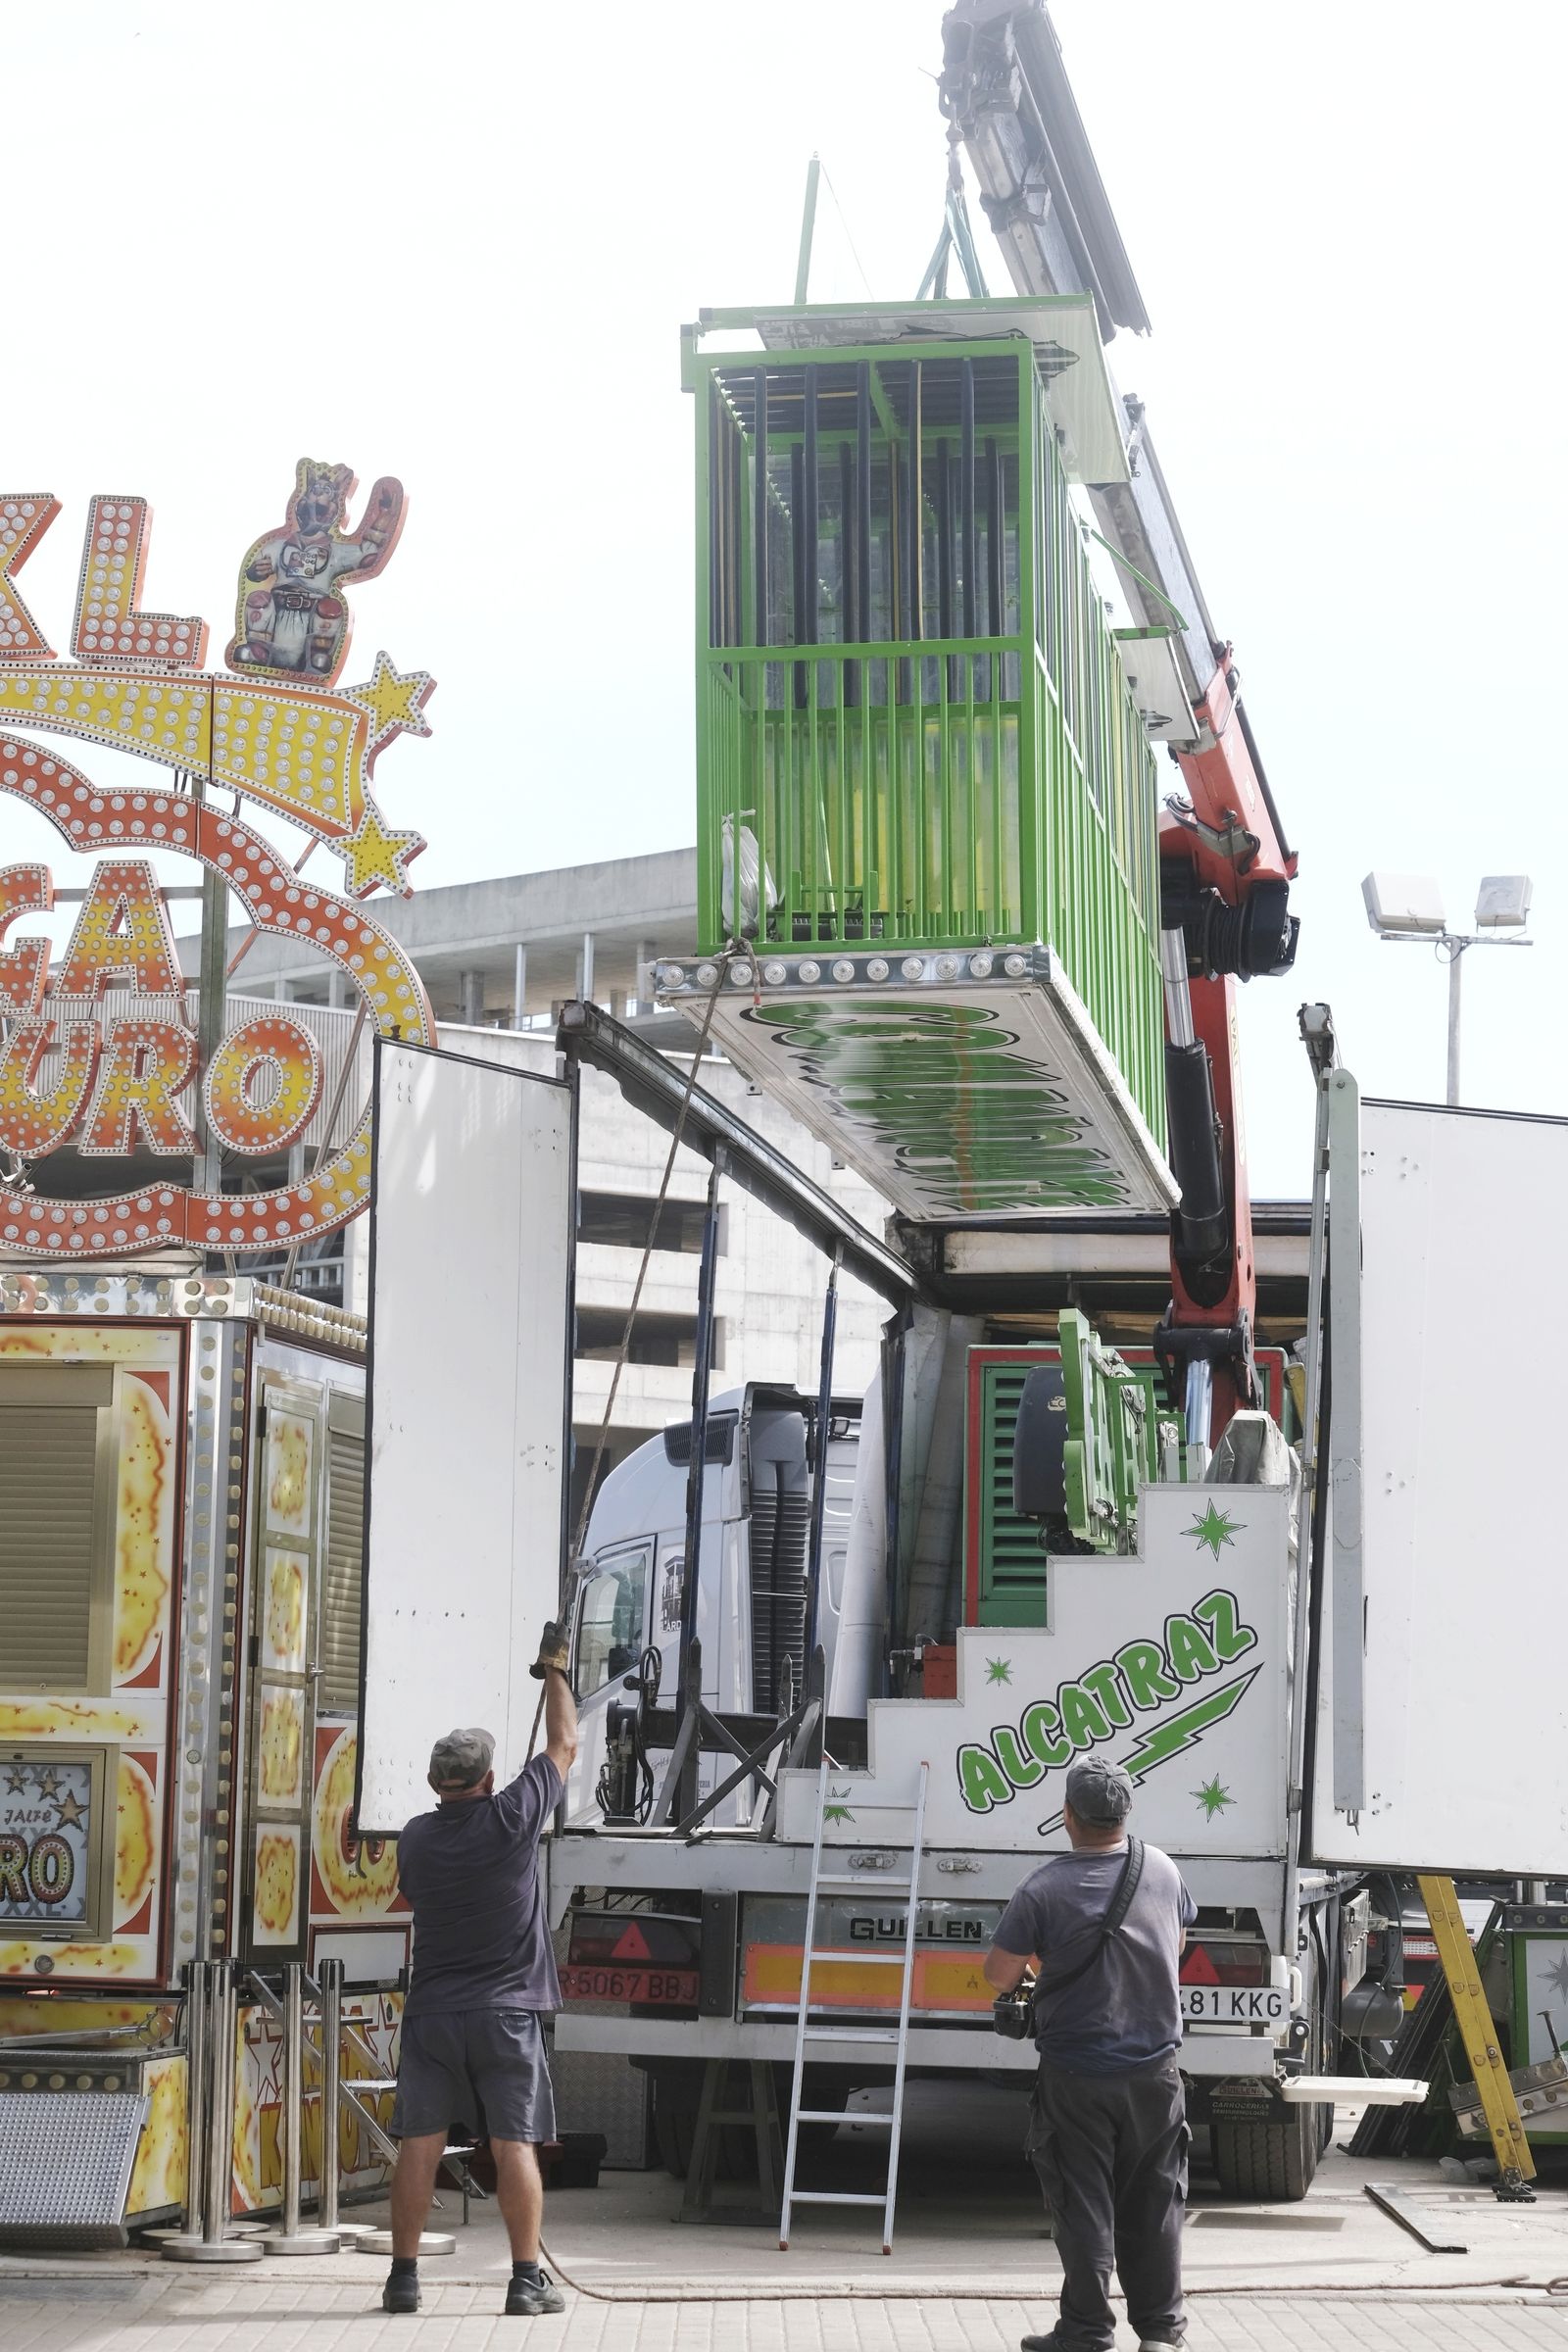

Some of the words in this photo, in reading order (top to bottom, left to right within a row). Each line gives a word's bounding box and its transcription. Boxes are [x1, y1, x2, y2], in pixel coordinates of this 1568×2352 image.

[739, 1000, 1131, 1211] COMANDANTE
[956, 1589, 1258, 1814] ALCATRAZ
[578, 1971, 641, 1997] 5067
[649, 1975, 698, 2000] BBJ
[1231, 1991, 1282, 2017] KKG
